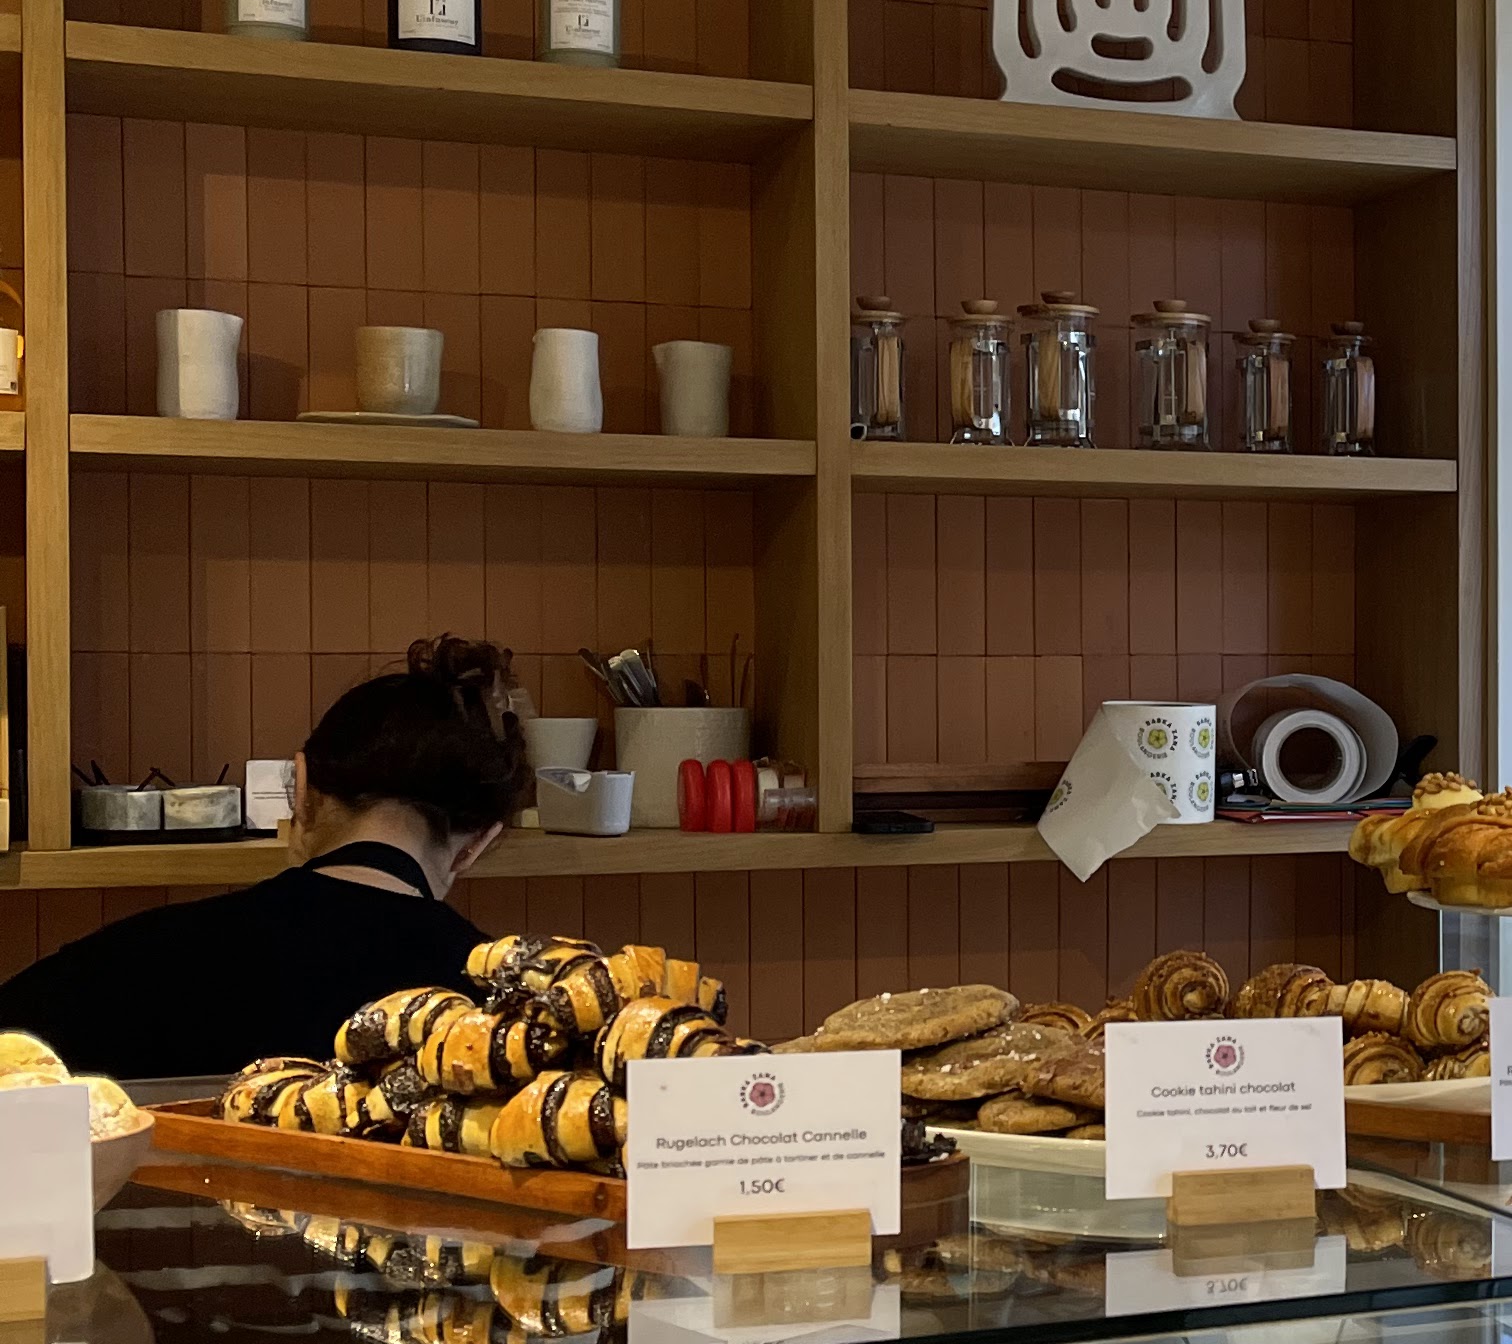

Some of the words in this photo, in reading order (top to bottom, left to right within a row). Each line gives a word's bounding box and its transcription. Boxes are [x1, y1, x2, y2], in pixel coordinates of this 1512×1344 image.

[1145, 717, 1172, 728] BABKA
[1170, 729, 1178, 751] ZANA
[1150, 771, 1171, 782] ABKA
[1151, 1085, 1196, 1098] Cookie
[1199, 1082, 1236, 1096] tahini
[1239, 1080, 1296, 1095] chocolat
[656, 1134, 726, 1151] Rugelach
[730, 1131, 797, 1147] Chocolat
[802, 1129, 867, 1144] Cannelle
[1205, 1143, 1248, 1159] 3,70€
[740, 1178, 785, 1196] 1,50€
